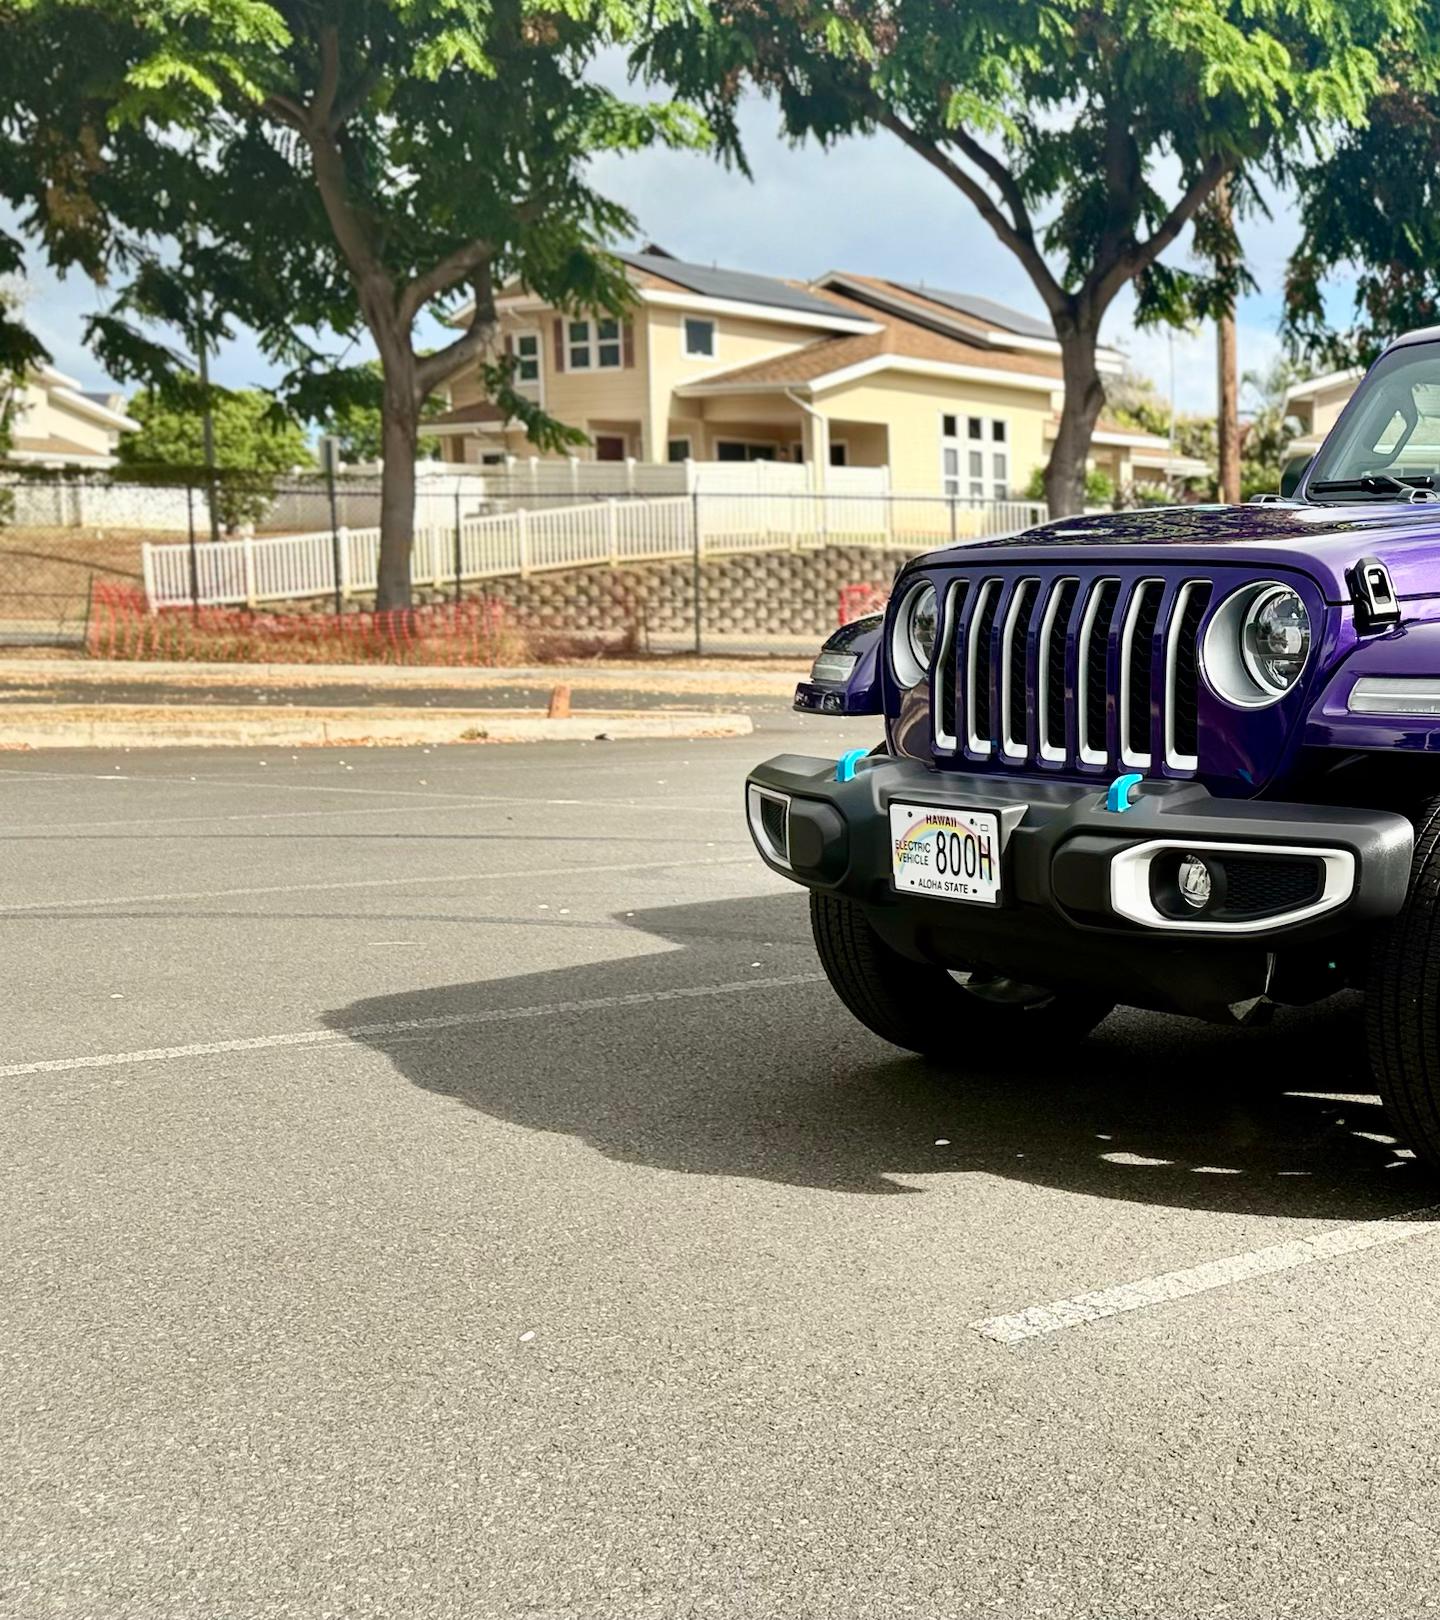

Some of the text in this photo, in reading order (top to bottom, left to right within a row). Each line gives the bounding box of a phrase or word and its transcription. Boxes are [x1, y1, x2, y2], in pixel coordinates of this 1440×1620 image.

[926, 814, 957, 828] HAWAII
[895, 839, 931, 852] ELECTRIC
[898, 854, 929, 866] VEHICLE
[936, 831, 993, 881] 800H
[918, 878, 969, 894] ALOHA STATE
